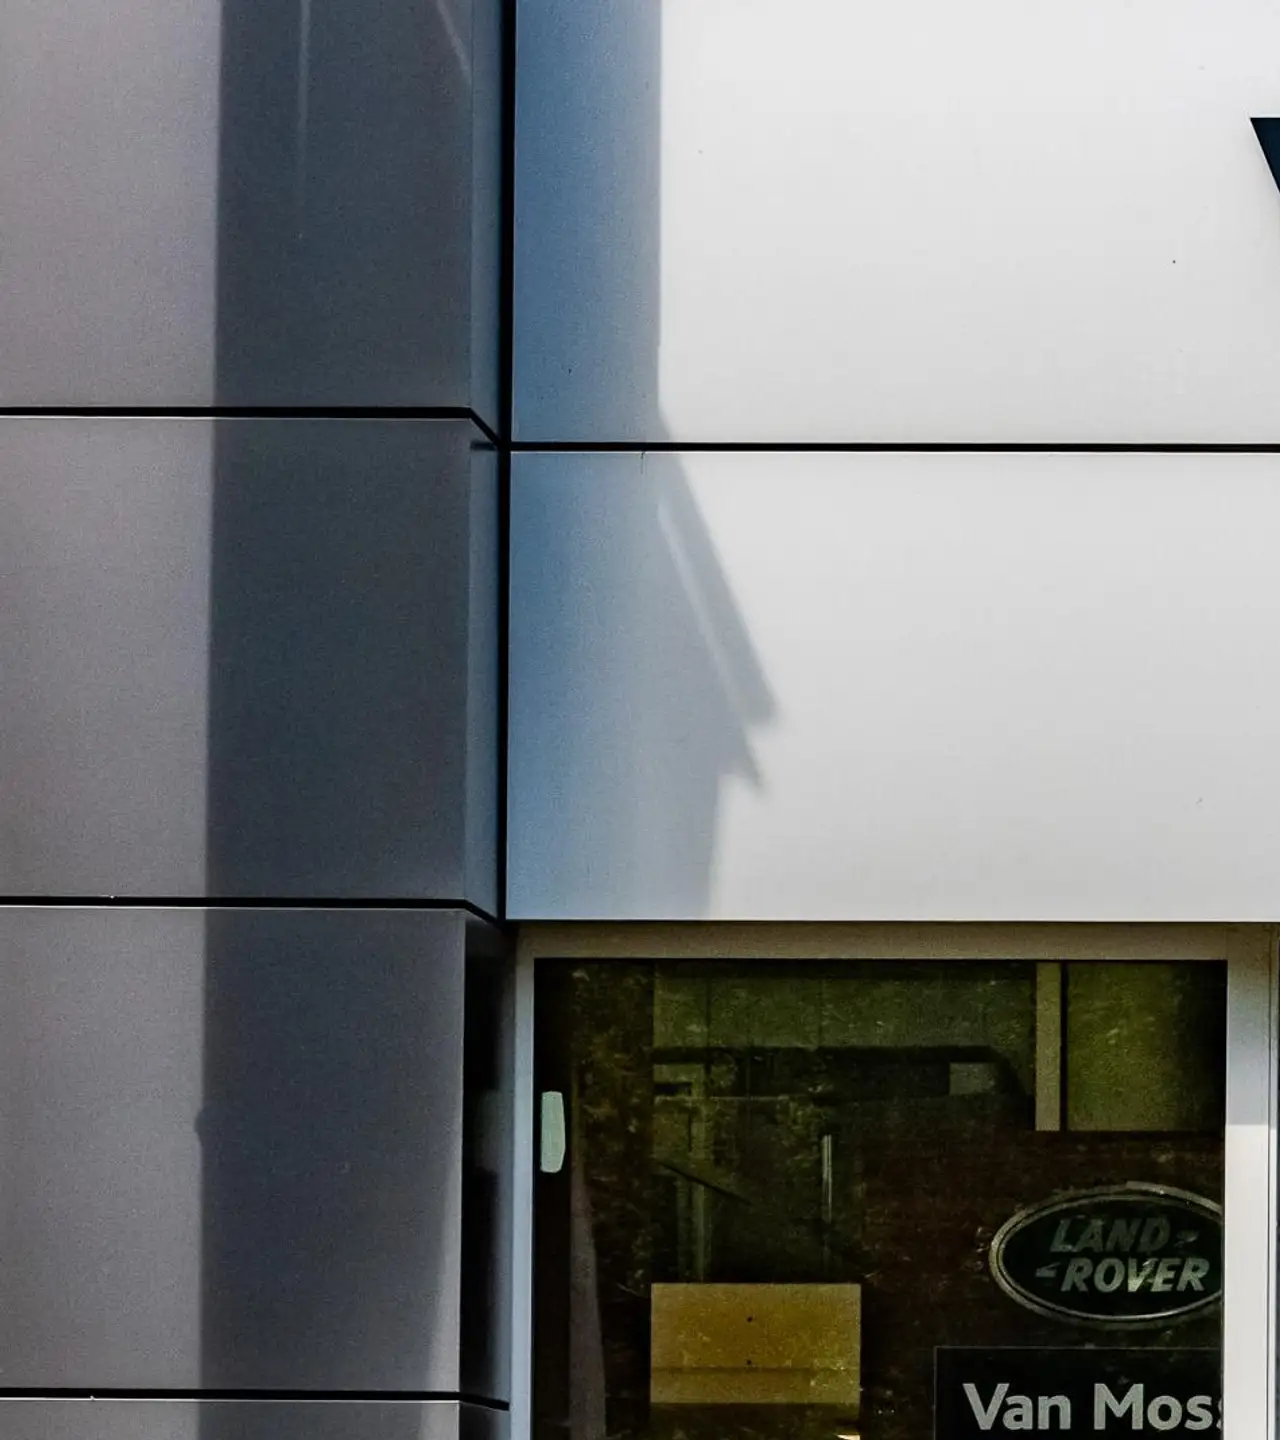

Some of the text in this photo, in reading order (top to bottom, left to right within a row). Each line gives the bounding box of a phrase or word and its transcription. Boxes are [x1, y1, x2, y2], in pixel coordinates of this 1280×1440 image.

[1050, 1215, 1170, 1252] LAND
[1060, 1257, 1210, 1293] ROVER
[962, 1383, 1223, 1431] Van Mos
